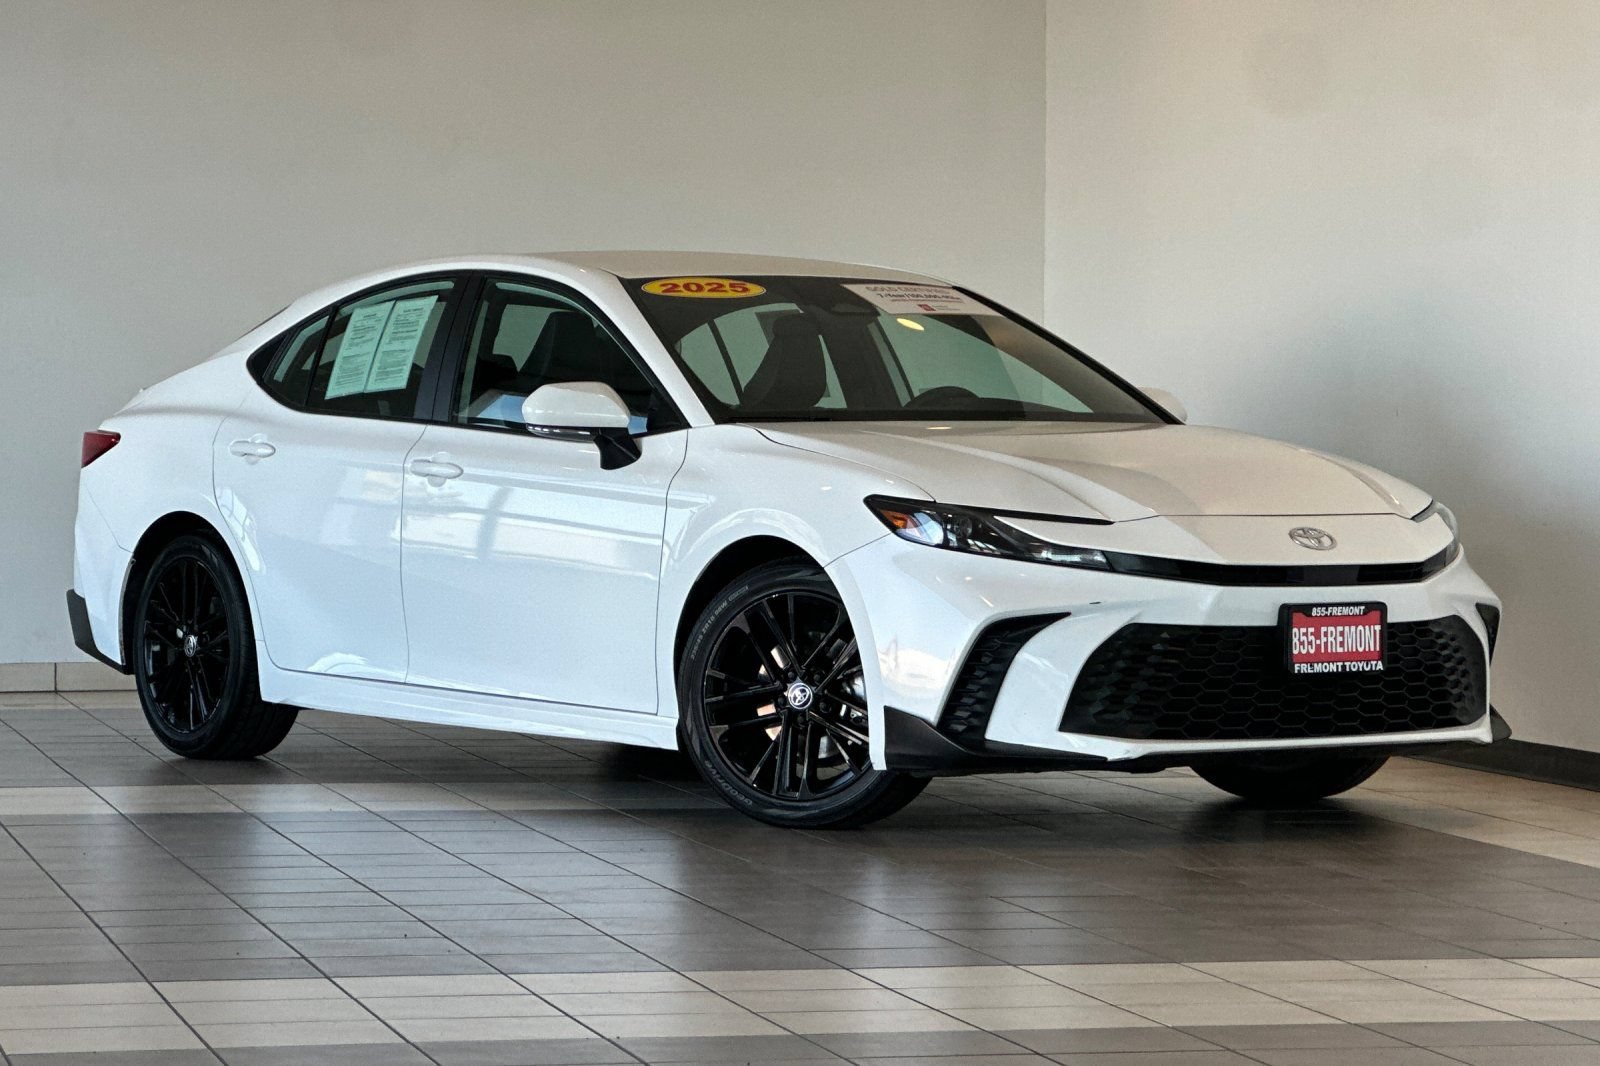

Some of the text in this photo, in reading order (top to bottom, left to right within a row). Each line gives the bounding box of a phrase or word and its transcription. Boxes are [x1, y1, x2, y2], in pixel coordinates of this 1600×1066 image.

[659, 281, 751, 294] 2025
[1311, 606, 1365, 616] 855-FREMONT
[1292, 624, 1382, 655] 855-FREMONT
[1294, 661, 1383, 673] FREMONT TOYOTA
